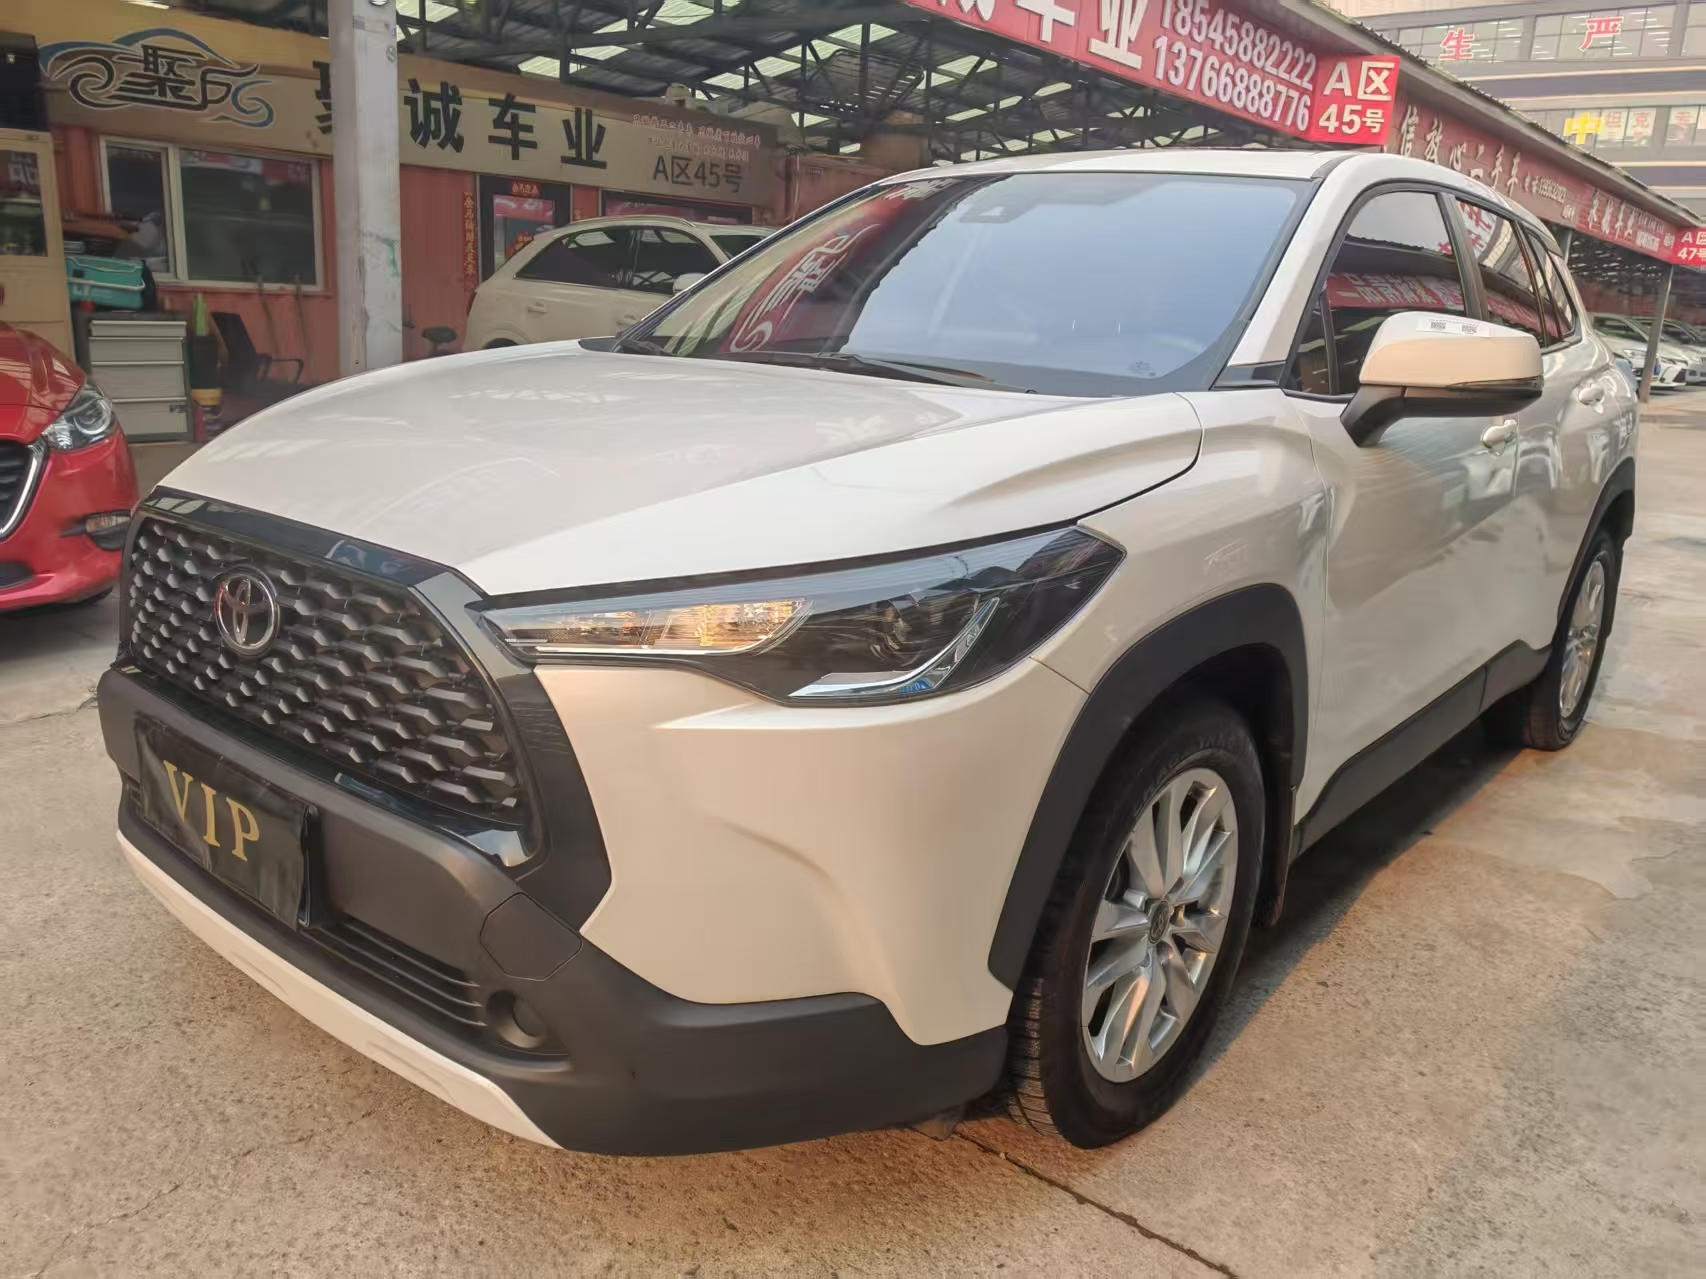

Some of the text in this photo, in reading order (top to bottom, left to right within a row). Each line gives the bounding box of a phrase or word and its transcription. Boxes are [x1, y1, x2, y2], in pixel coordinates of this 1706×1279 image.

[1160, 0, 1317, 91] 18545882222
[1439, 16, 1624, 61] 生 严
[1153, 35, 1312, 132] 13766888776
[1323, 60, 1396, 102] A区
[1318, 103, 1385, 134] 45号
[653, 155, 744, 193] A区45号
[163, 760, 260, 863] VIP
